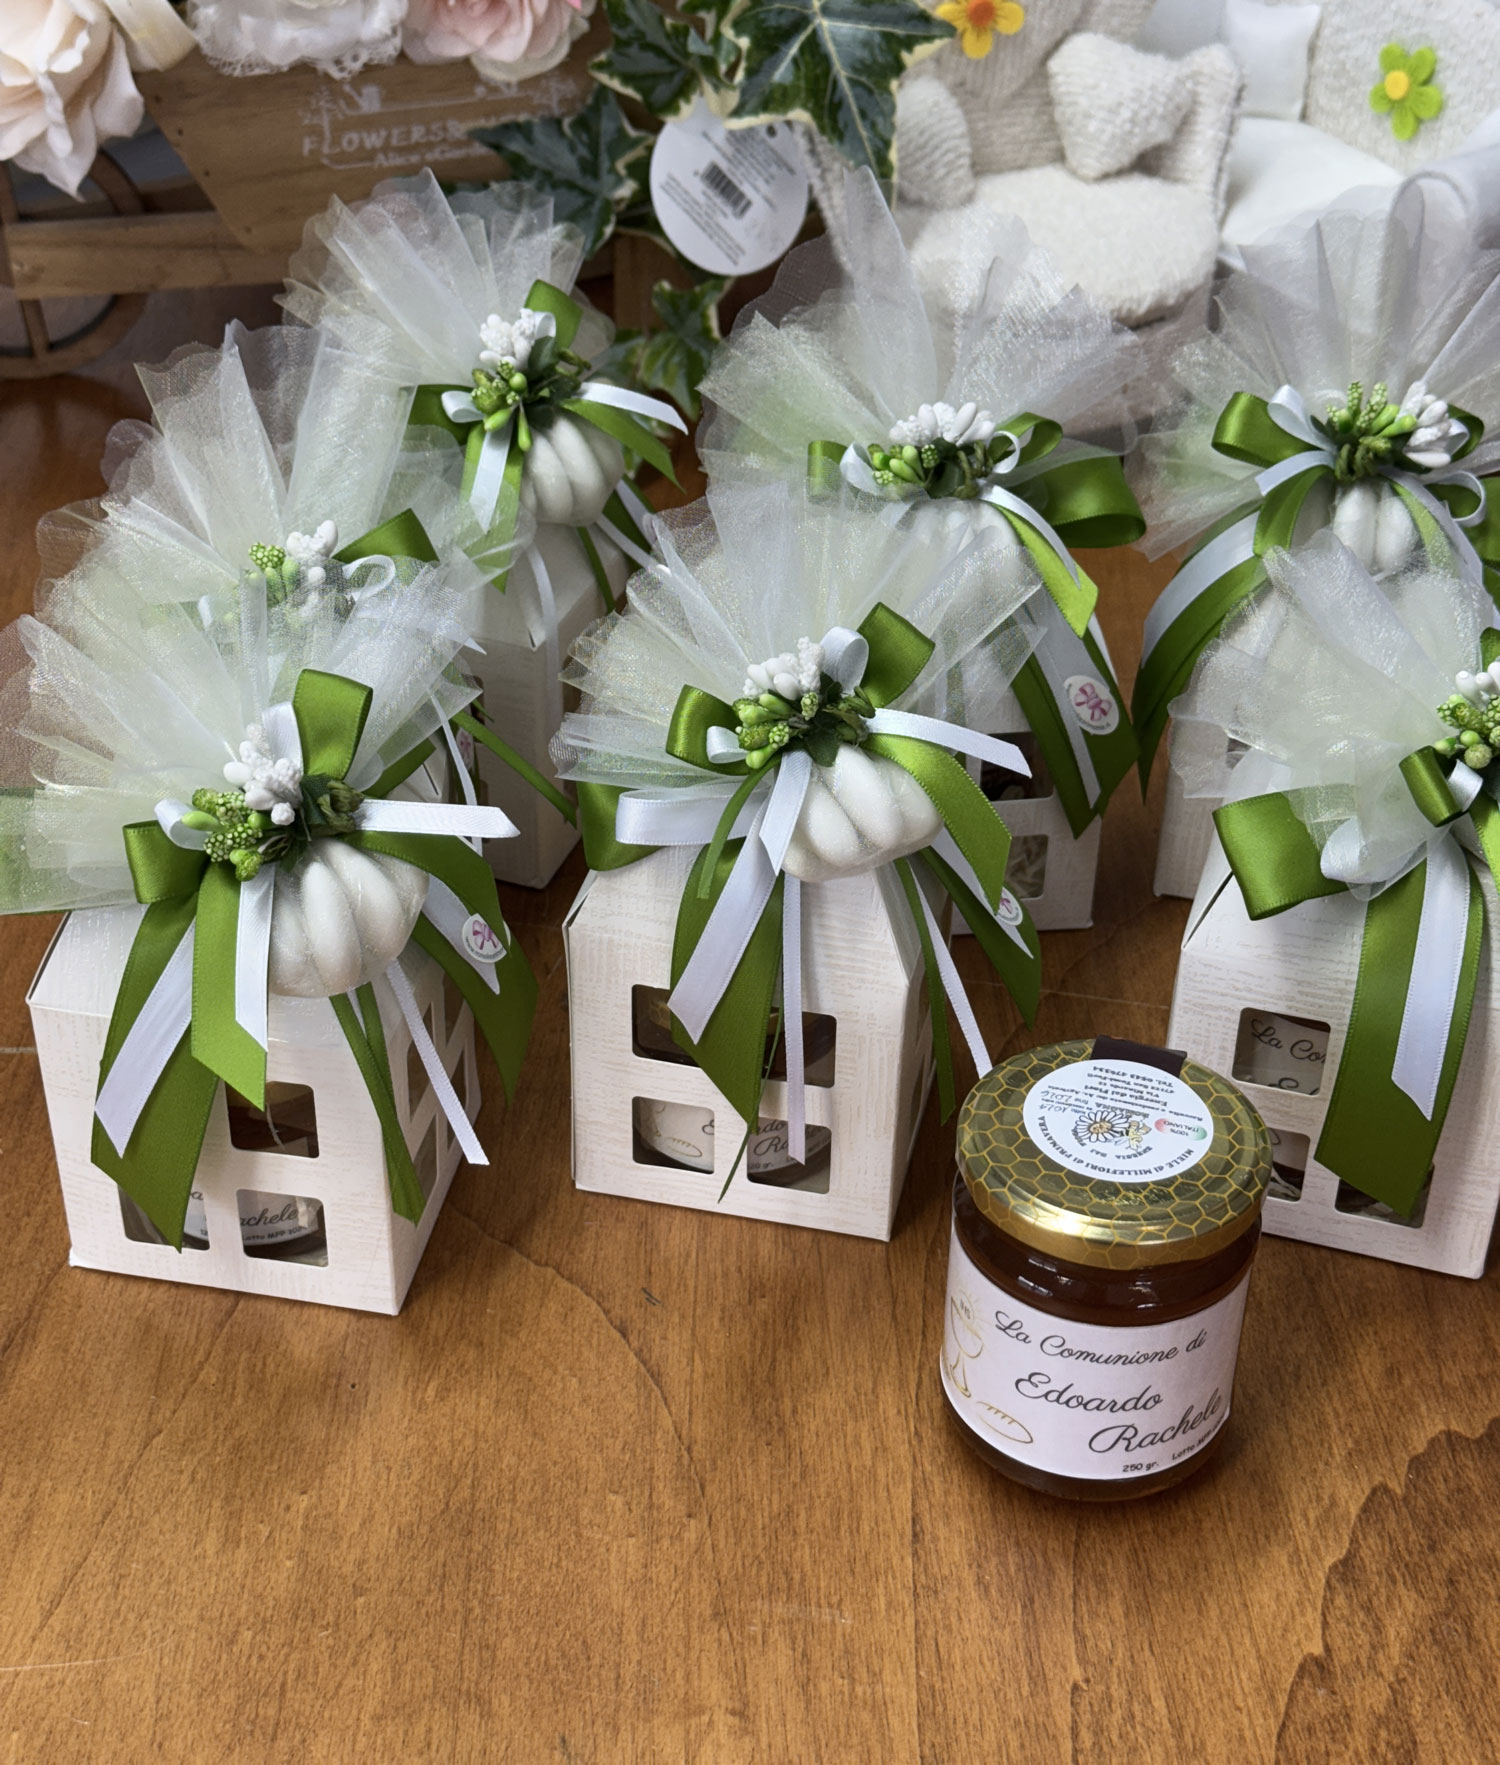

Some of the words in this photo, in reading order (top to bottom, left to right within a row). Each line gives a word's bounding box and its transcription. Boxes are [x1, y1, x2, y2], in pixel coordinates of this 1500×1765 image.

[1251, 1018, 1283, 1049] La
[1084, 1085, 1109, 1095] Fiori
[1155, 1079, 1173, 1088] Tel.
[1128, 1093, 1168, 1107] Energia
[1163, 1120, 1200, 1133] ITALIANO
[1169, 1128, 1189, 1137] 100%
[1038, 1116, 1073, 1159] PRIMAVERA
[1073, 1157, 1085, 1165] di
[1165, 1149, 1195, 1169] MIELE
[1085, 1162, 1153, 1176] MILLEFIORI
[1153, 1165, 1165, 1174] di
[995, 1310, 1031, 1345] La
[1039, 1334, 1179, 1366] Comunione
[1185, 1327, 1207, 1353] di
[1014, 1371, 1164, 1414] Edoardo
[1122, 1463, 1143, 1473] 250
[1145, 1461, 1160, 1473] gr.
[1171, 1443, 1196, 1461] Lotto
